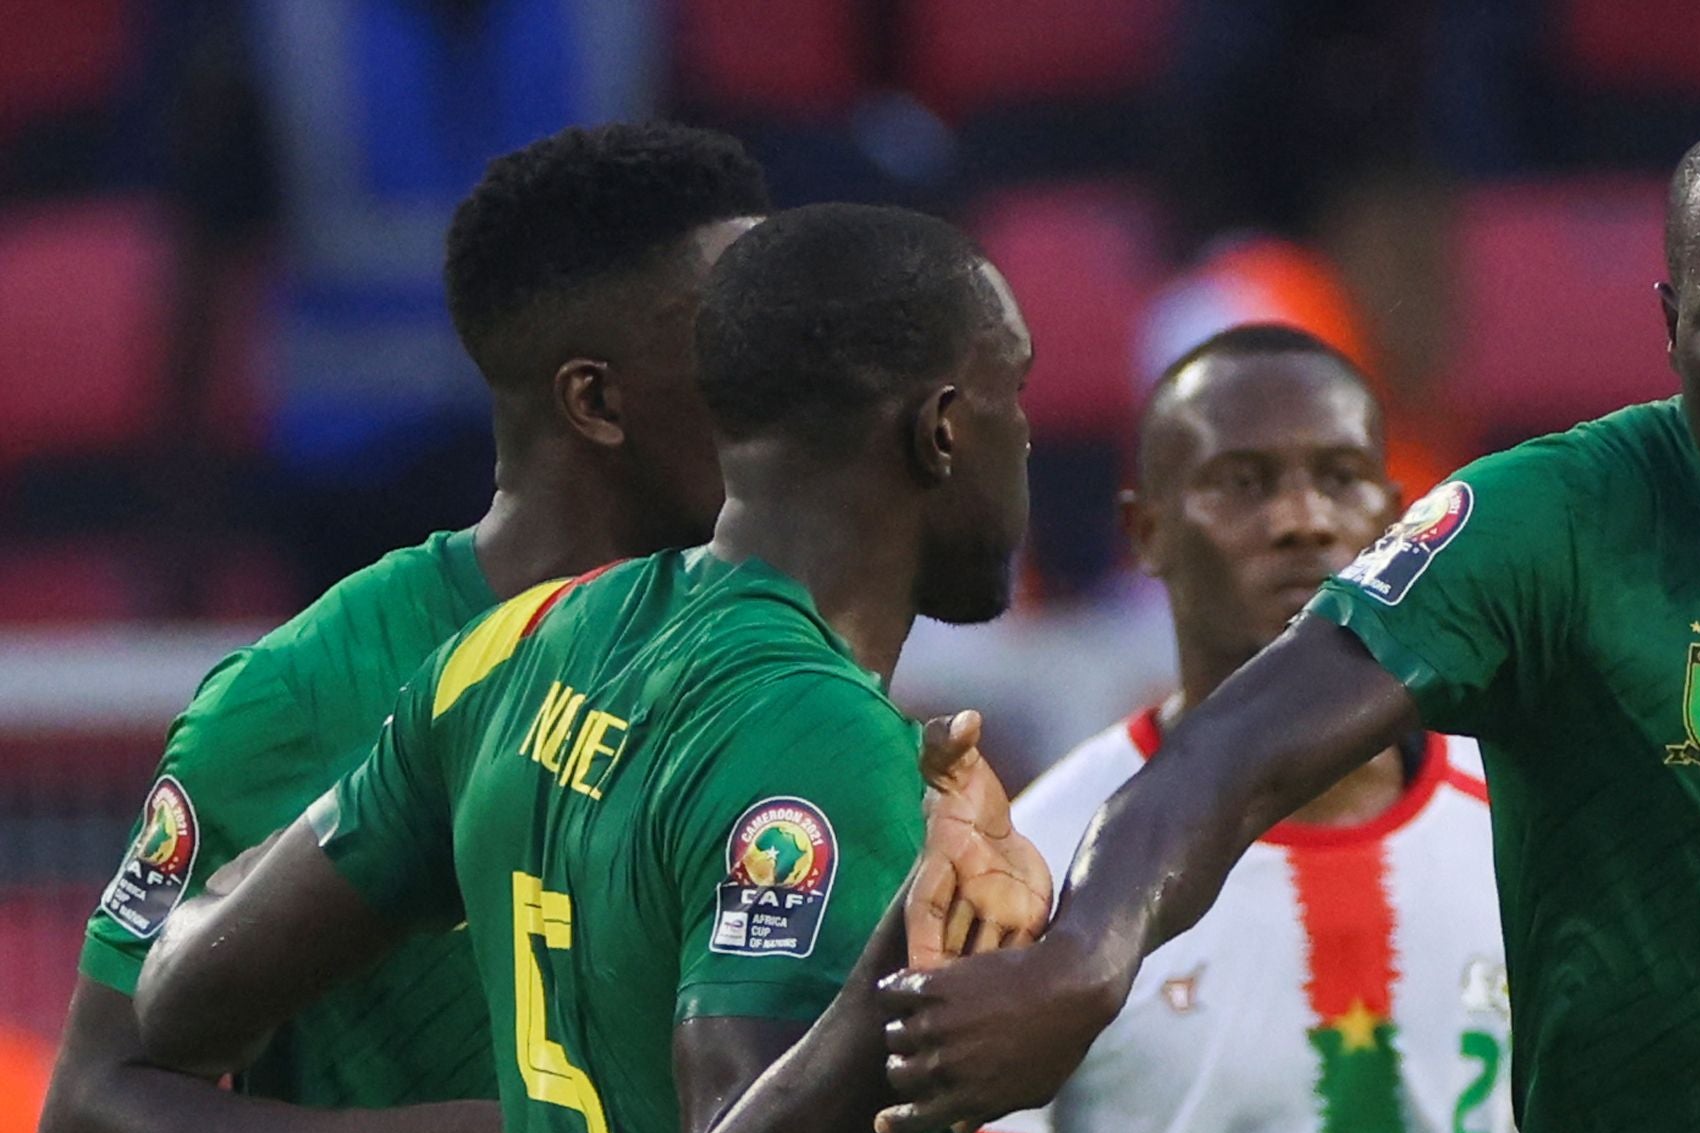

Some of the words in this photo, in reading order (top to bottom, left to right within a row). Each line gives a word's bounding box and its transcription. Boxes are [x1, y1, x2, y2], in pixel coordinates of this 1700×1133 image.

[741, 808, 803, 843] CAMEROON
[800, 816, 825, 847] 2021
[740, 889, 804, 909] CAF
[752, 913, 787, 928] AFRICA
[751, 925, 771, 937] CUP
[749, 937, 763, 948] OF
[763, 938, 797, 948] NATIONS
